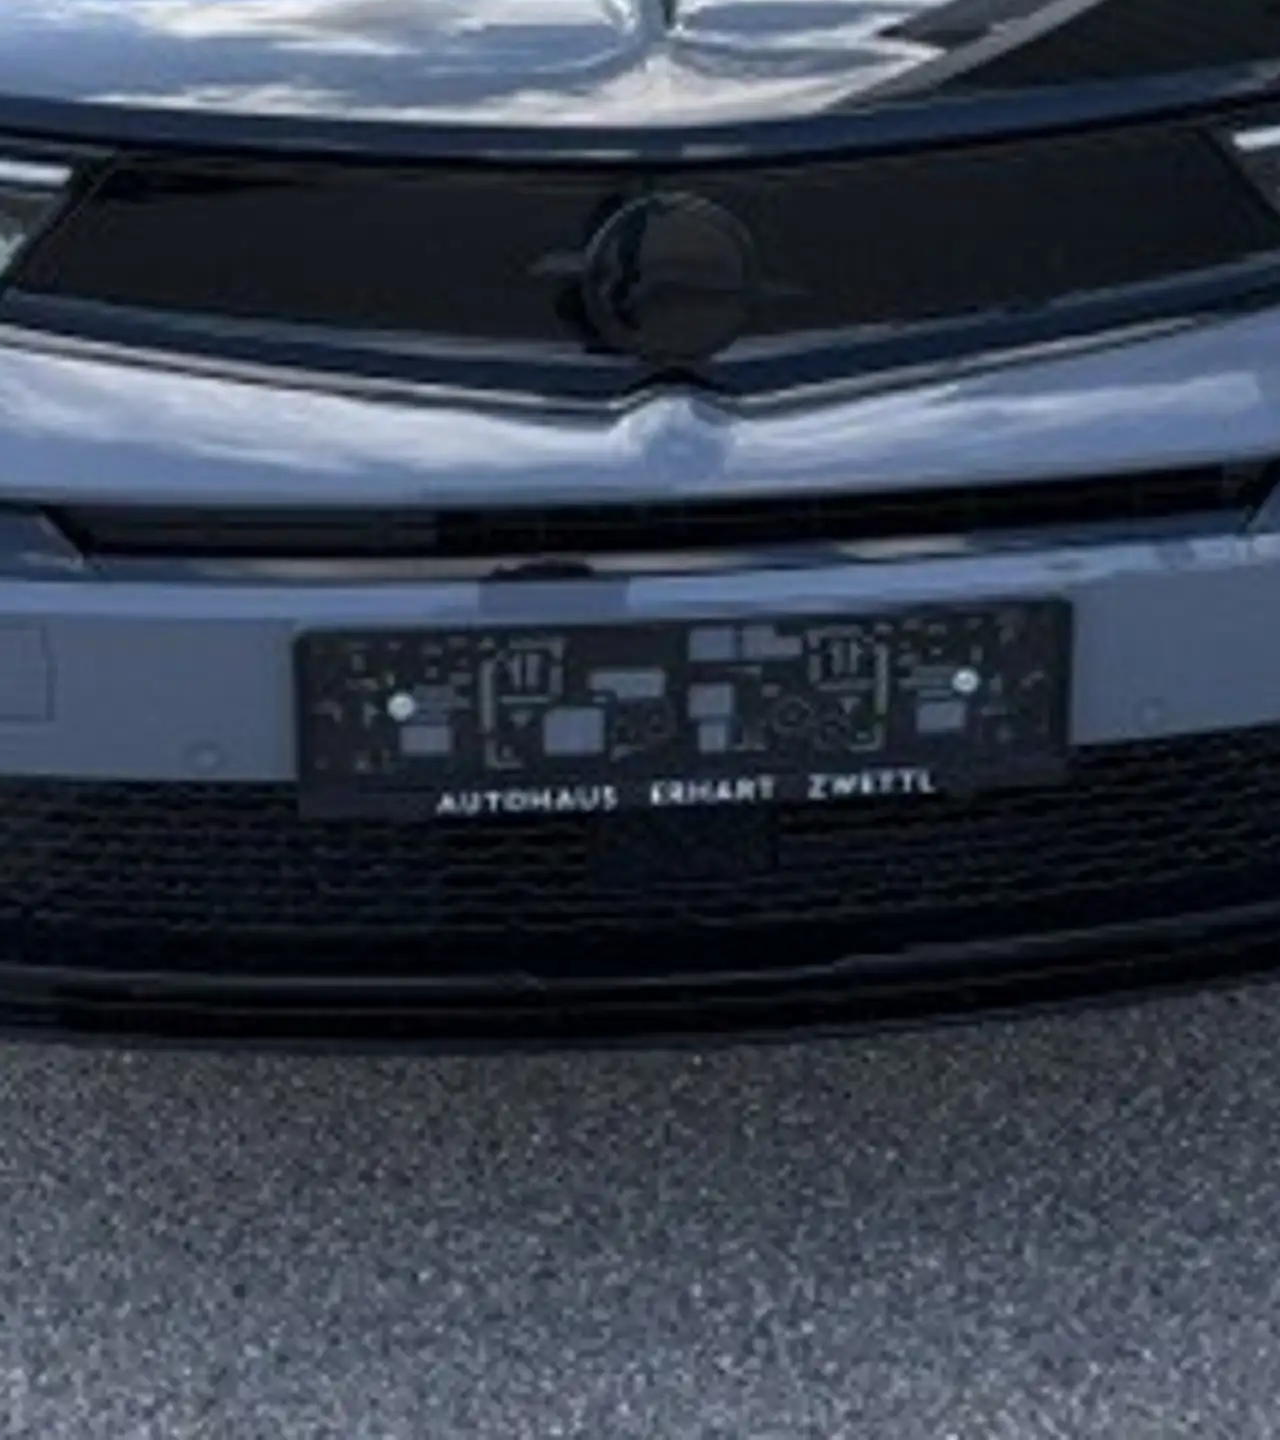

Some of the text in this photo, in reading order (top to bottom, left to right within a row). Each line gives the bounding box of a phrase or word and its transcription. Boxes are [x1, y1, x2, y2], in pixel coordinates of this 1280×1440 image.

[435, 768, 936, 815] AUTOHAUS ERHART ZWETTL
